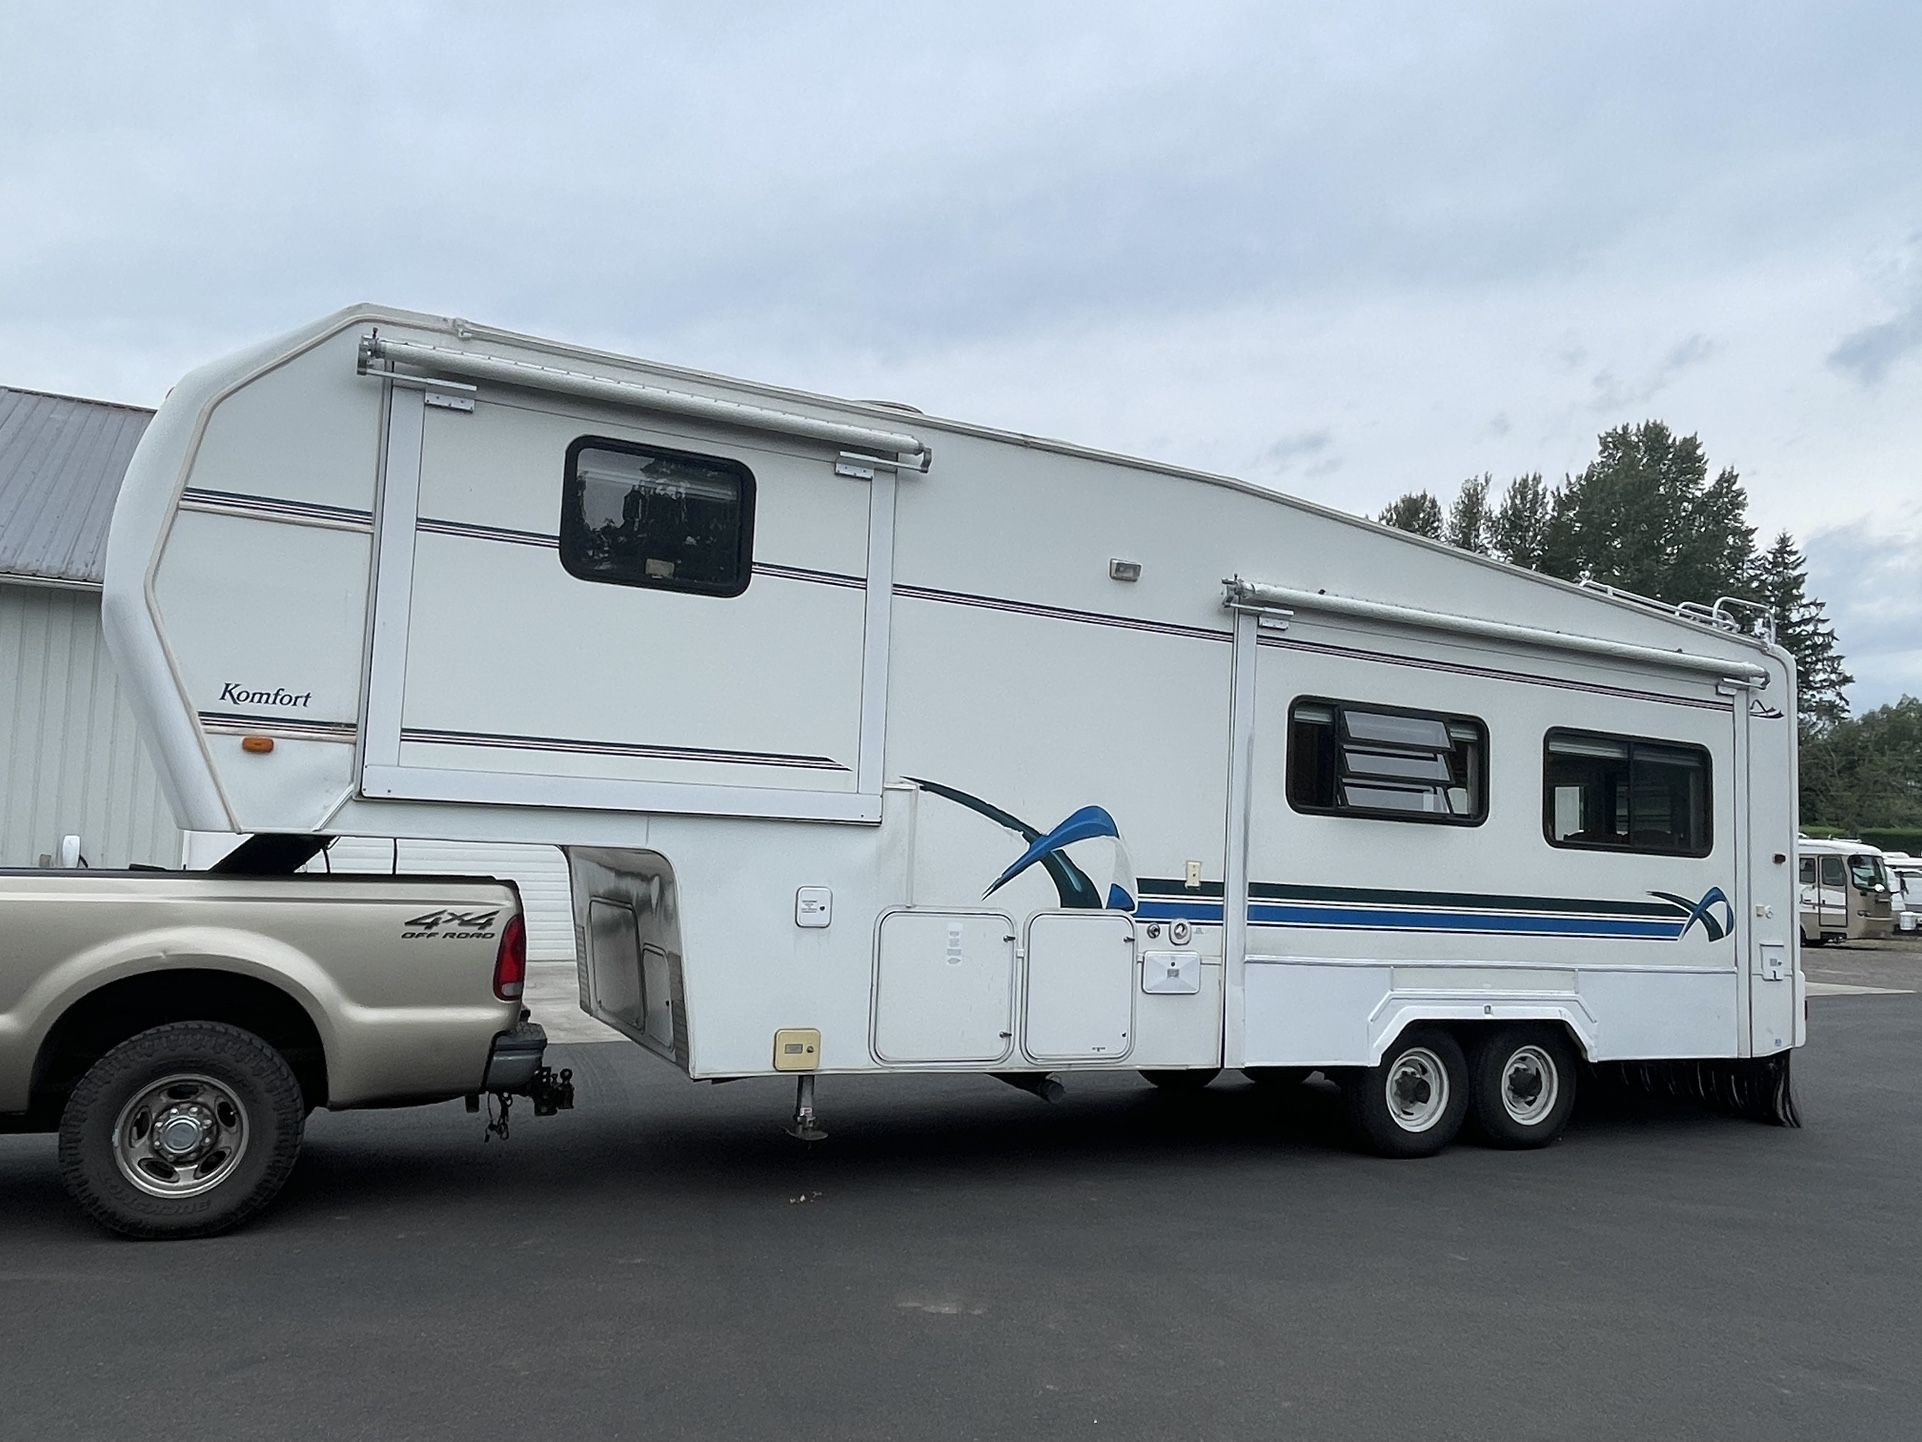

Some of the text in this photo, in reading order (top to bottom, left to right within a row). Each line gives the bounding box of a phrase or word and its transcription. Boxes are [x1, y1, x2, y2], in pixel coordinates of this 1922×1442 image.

[219, 682, 312, 708] Komfort
[401, 932, 495, 940] OFF ROAD
